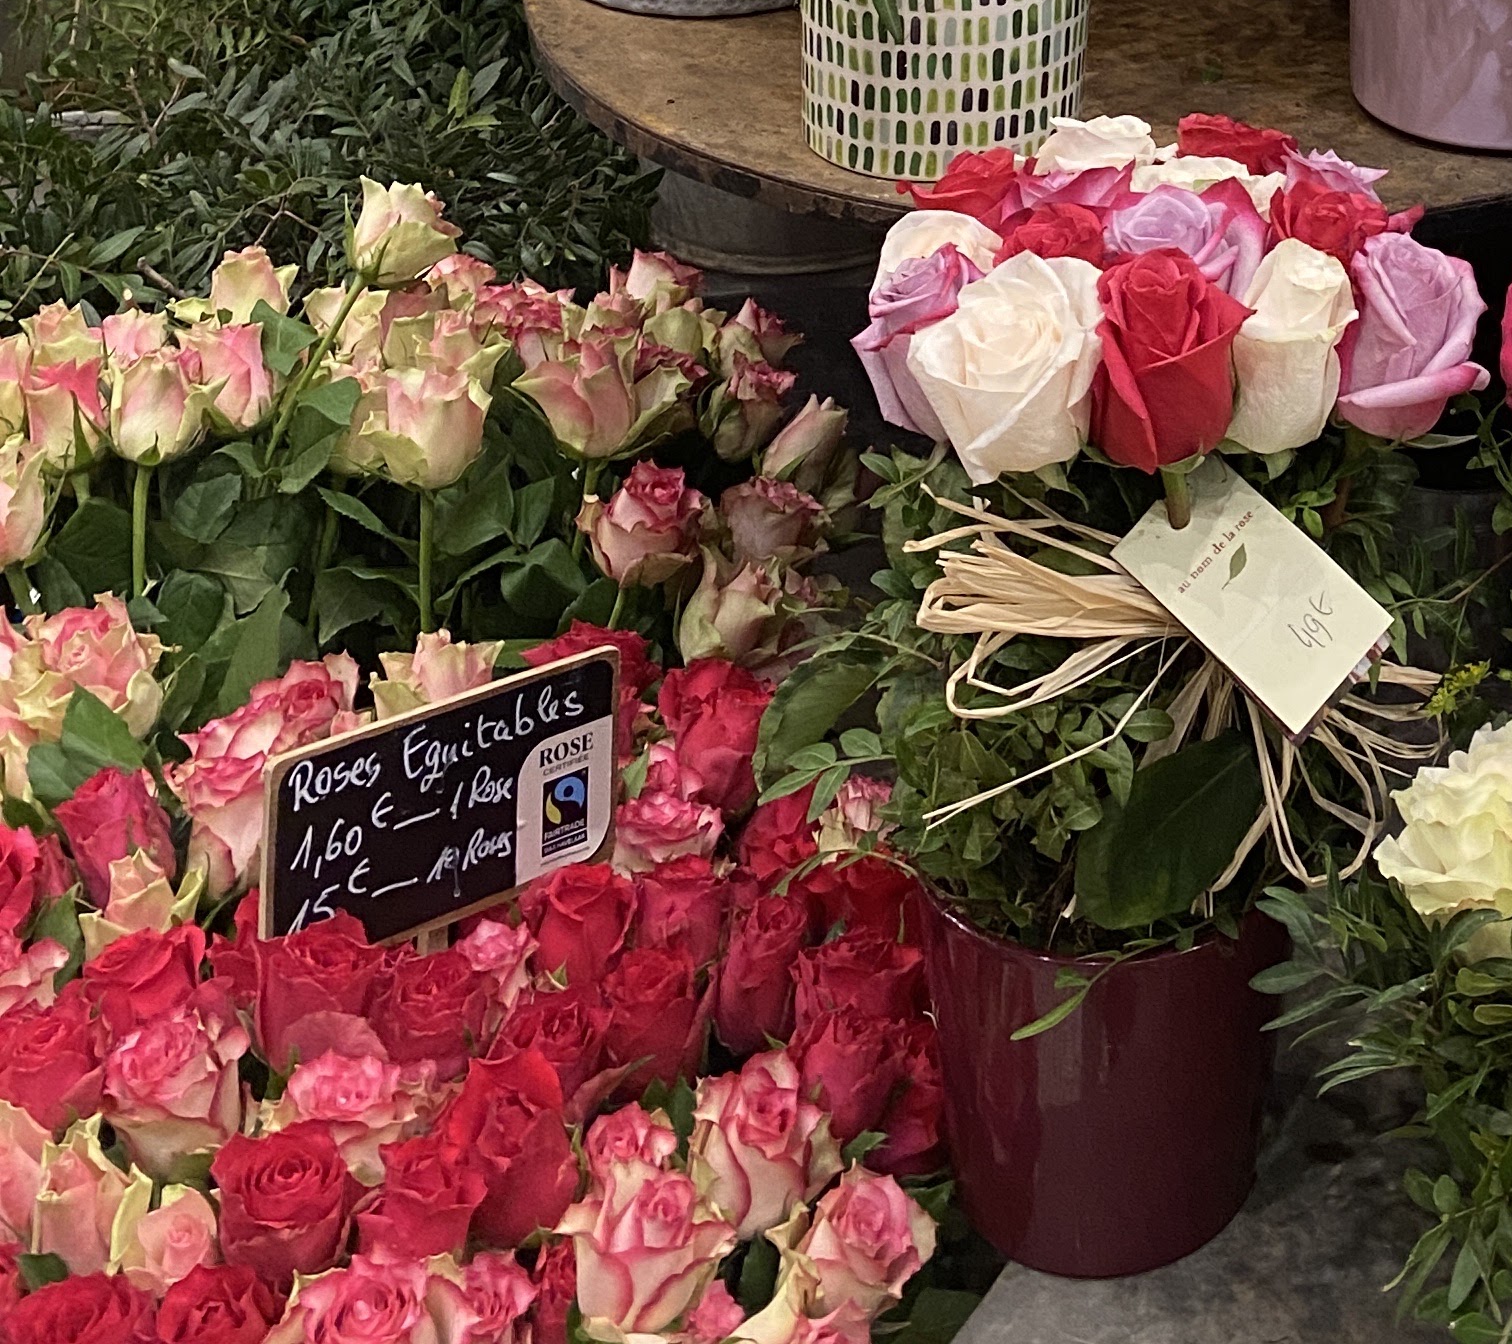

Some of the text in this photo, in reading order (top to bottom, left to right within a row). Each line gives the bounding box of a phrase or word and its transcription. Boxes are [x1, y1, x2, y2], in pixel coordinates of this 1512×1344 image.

[1177, 511, 1254, 594] au nom de la rose
[539, 731, 594, 769] ROSE
[288, 751, 382, 812] Roses
[467, 765, 514, 809] Rose
[543, 817, 586, 842] FAIRTRADE
